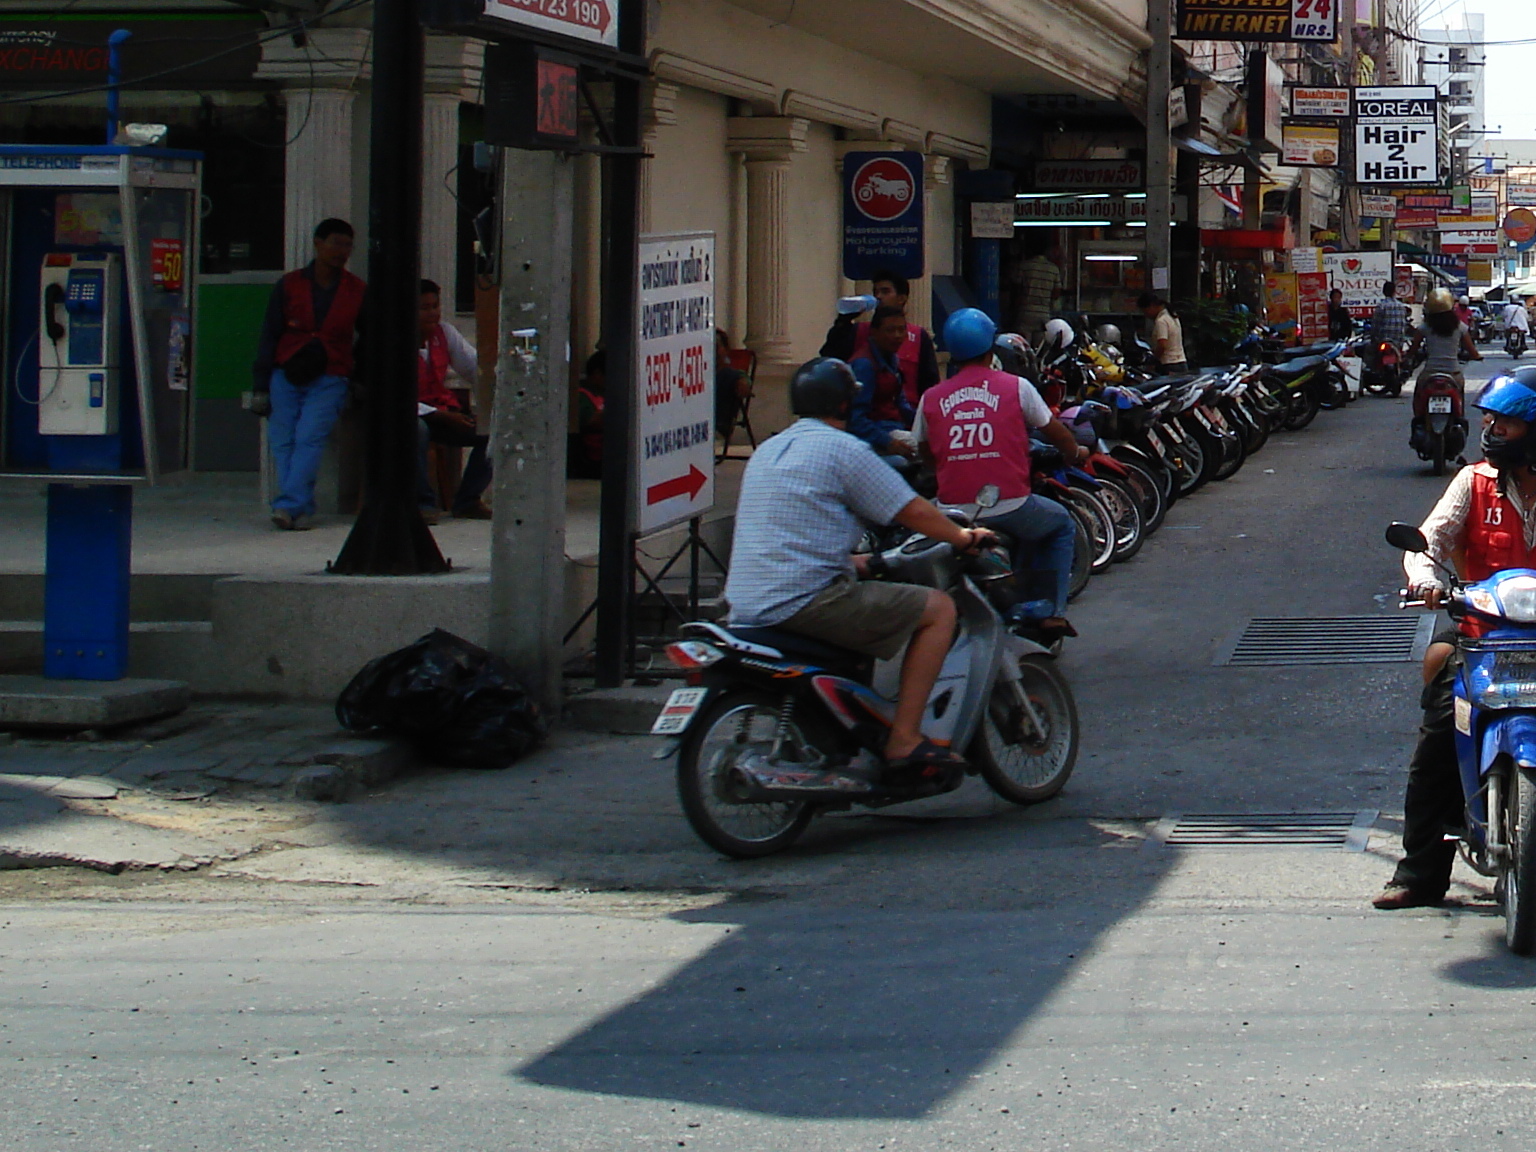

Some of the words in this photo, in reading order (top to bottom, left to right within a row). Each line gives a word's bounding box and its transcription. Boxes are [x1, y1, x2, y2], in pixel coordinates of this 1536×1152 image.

[571, 1, 601, 26] 190
[1184, 13, 1288, 33] INTERNET
[1294, 24, 1332, 36] HRS.
[1364, 126, 1427, 144] Hair
[1388, 144, 1405, 161] 2
[1364, 162, 1427, 180] Hair
[162, 252, 183, 282] 50
[704, 253, 710, 282] 2
[948, 422, 994, 450] 270
[1484, 507, 1503, 526] 13
